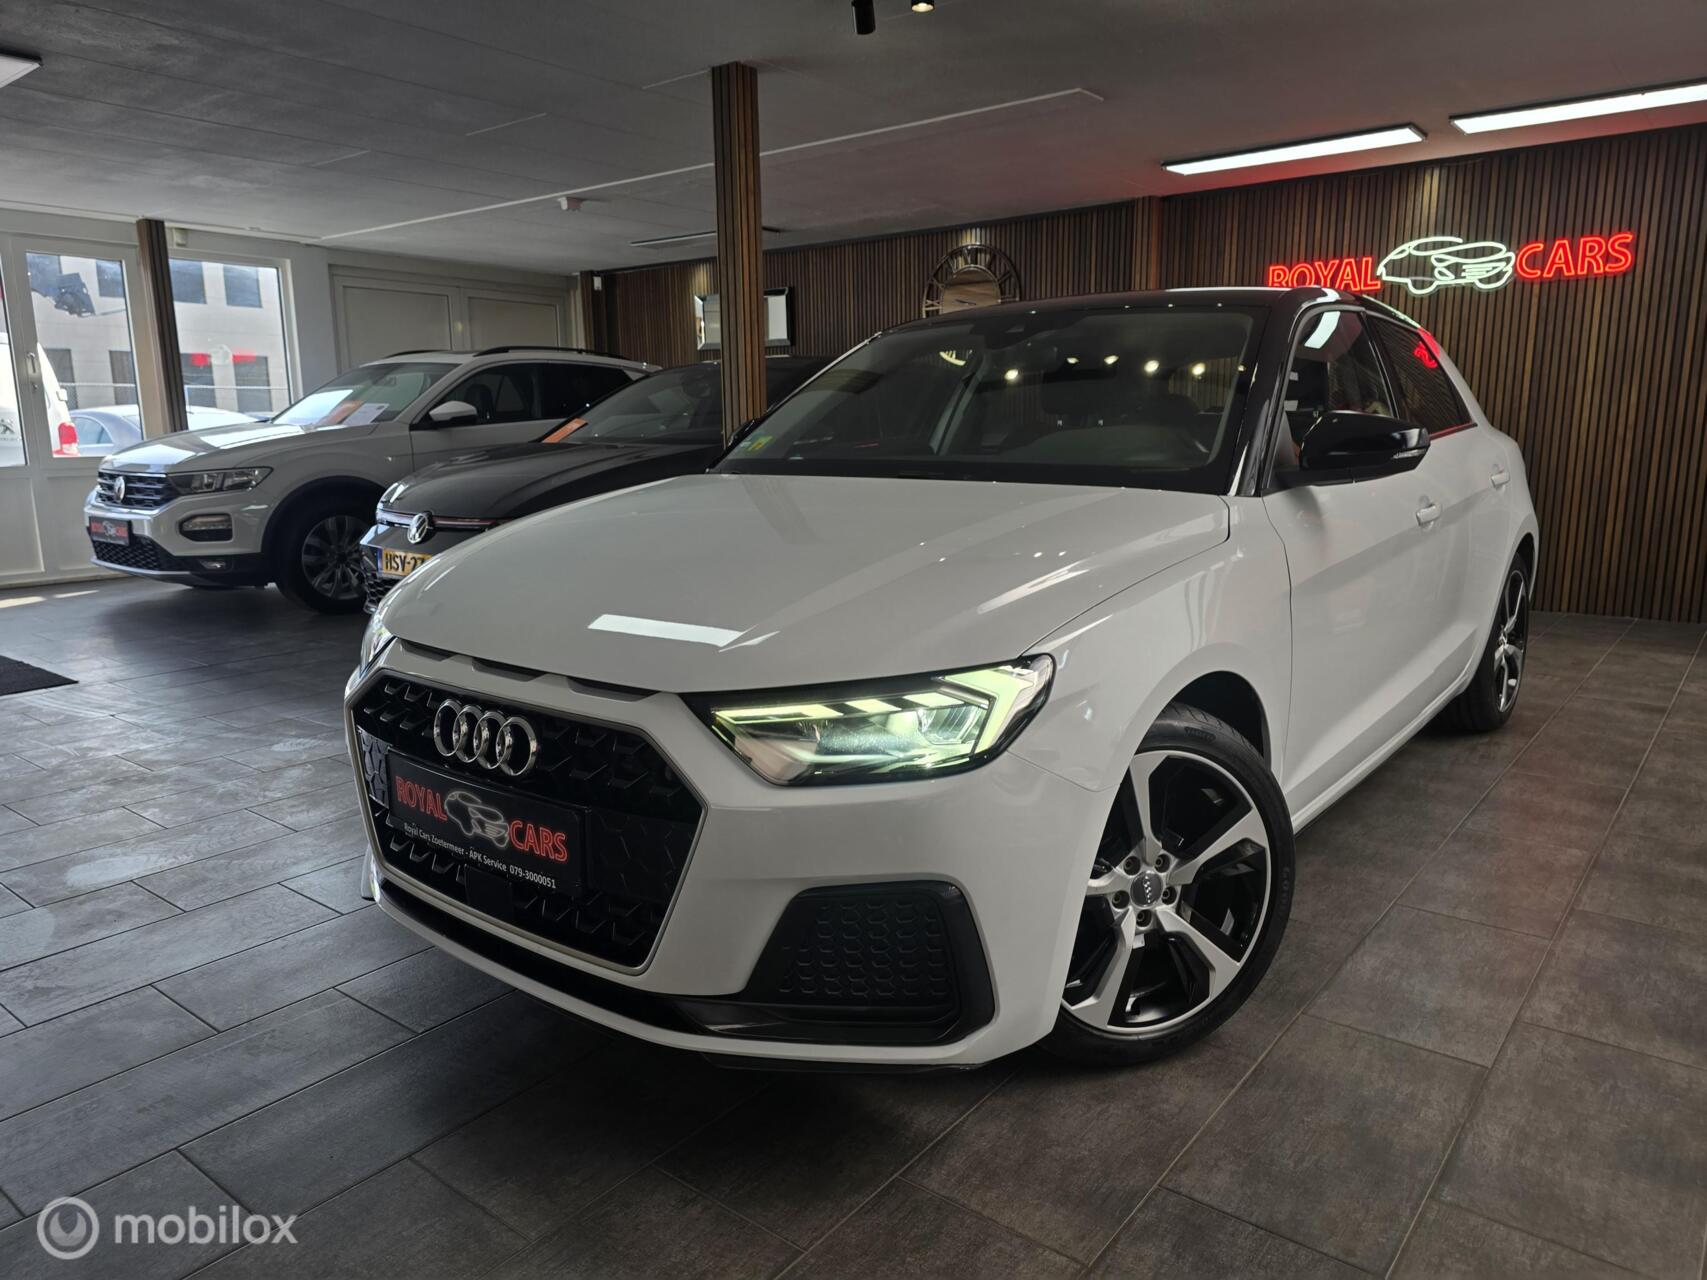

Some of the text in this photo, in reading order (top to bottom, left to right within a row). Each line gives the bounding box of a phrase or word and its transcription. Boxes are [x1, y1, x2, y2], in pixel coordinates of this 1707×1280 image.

[1268, 233, 1633, 291] ROYAL CARS
[396, 776, 568, 862] ROYAL CARS
[419, 829, 431, 841] Cars
[469, 850, 482, 862] APK
[482, 856, 507, 872] Service
[509, 864, 556, 889] 079-3000051
